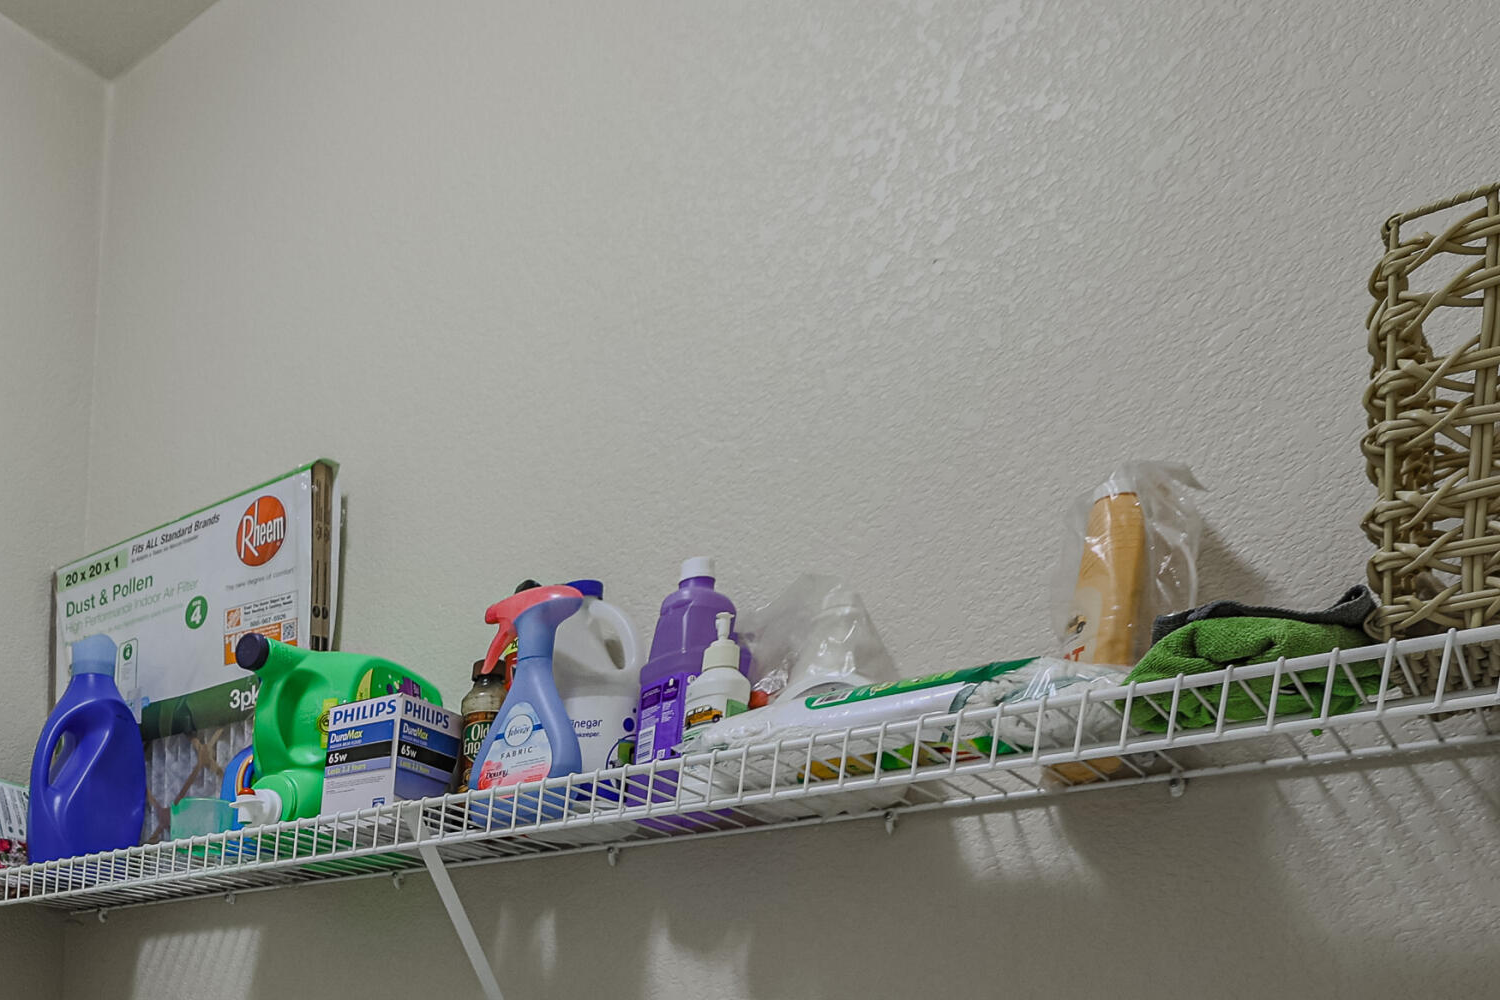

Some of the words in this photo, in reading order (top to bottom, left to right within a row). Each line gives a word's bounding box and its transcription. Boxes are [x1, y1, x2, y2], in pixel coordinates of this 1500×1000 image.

[132, 544, 144, 555] Fits
[146, 537, 158, 548] ALL
[160, 525, 193, 545] Standard
[194, 513, 220, 532] Brands
[241, 500, 284, 558] Rheem
[66, 572, 78, 587] 20
[80, 572, 86, 581] x
[89, 562, 101, 578] 20
[105, 562, 110, 572] x
[114, 556, 119, 568] 1
[66, 594, 95, 618] Dust
[100, 589, 108, 606] &
[112, 575, 154, 601] Pollen
[66, 620, 81, 634] High
[164, 587, 174, 599] Air
[332, 700, 396, 725] PHILIPS
[404, 700, 449, 729] PHILIPS
[570, 718, 603, 729] inegar
[330, 729, 364, 744] DuraMax
[402, 723, 428, 740] DuraMax
[471, 724, 490, 741] Old
[464, 738, 484, 757] Eng
[500, 747, 532, 760] FABRIC
